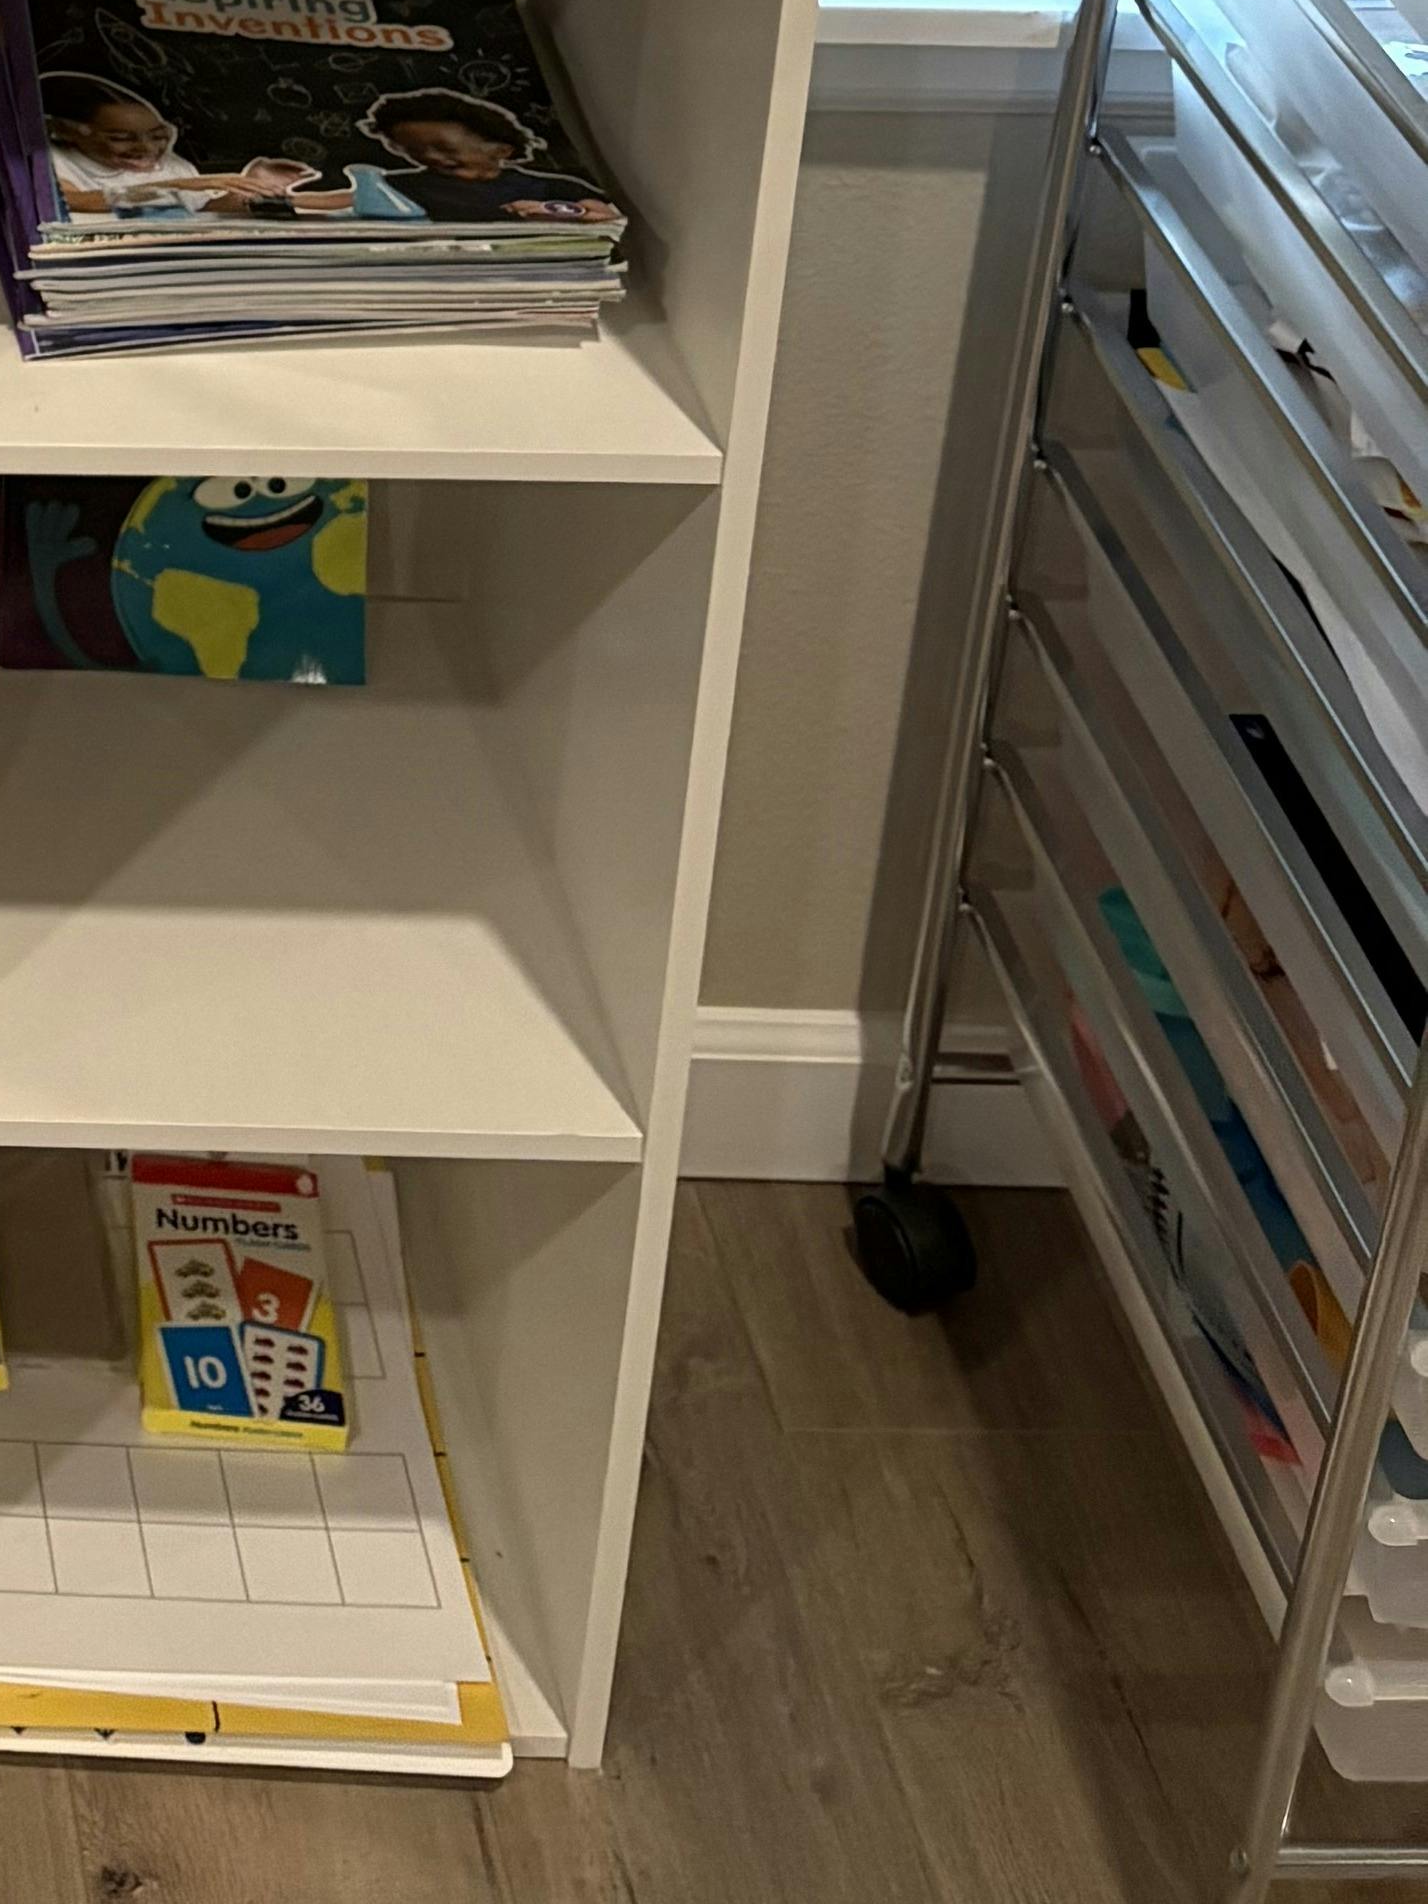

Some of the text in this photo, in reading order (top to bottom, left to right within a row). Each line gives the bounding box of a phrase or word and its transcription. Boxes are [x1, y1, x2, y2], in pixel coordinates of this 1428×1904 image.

[149, 3, 447, 48] Inventions
[156, 1208, 299, 1240] Numbers
[252, 1294, 280, 1323] 3
[184, 1355, 227, 1389] 10
[298, 1395, 325, 1413] 36
